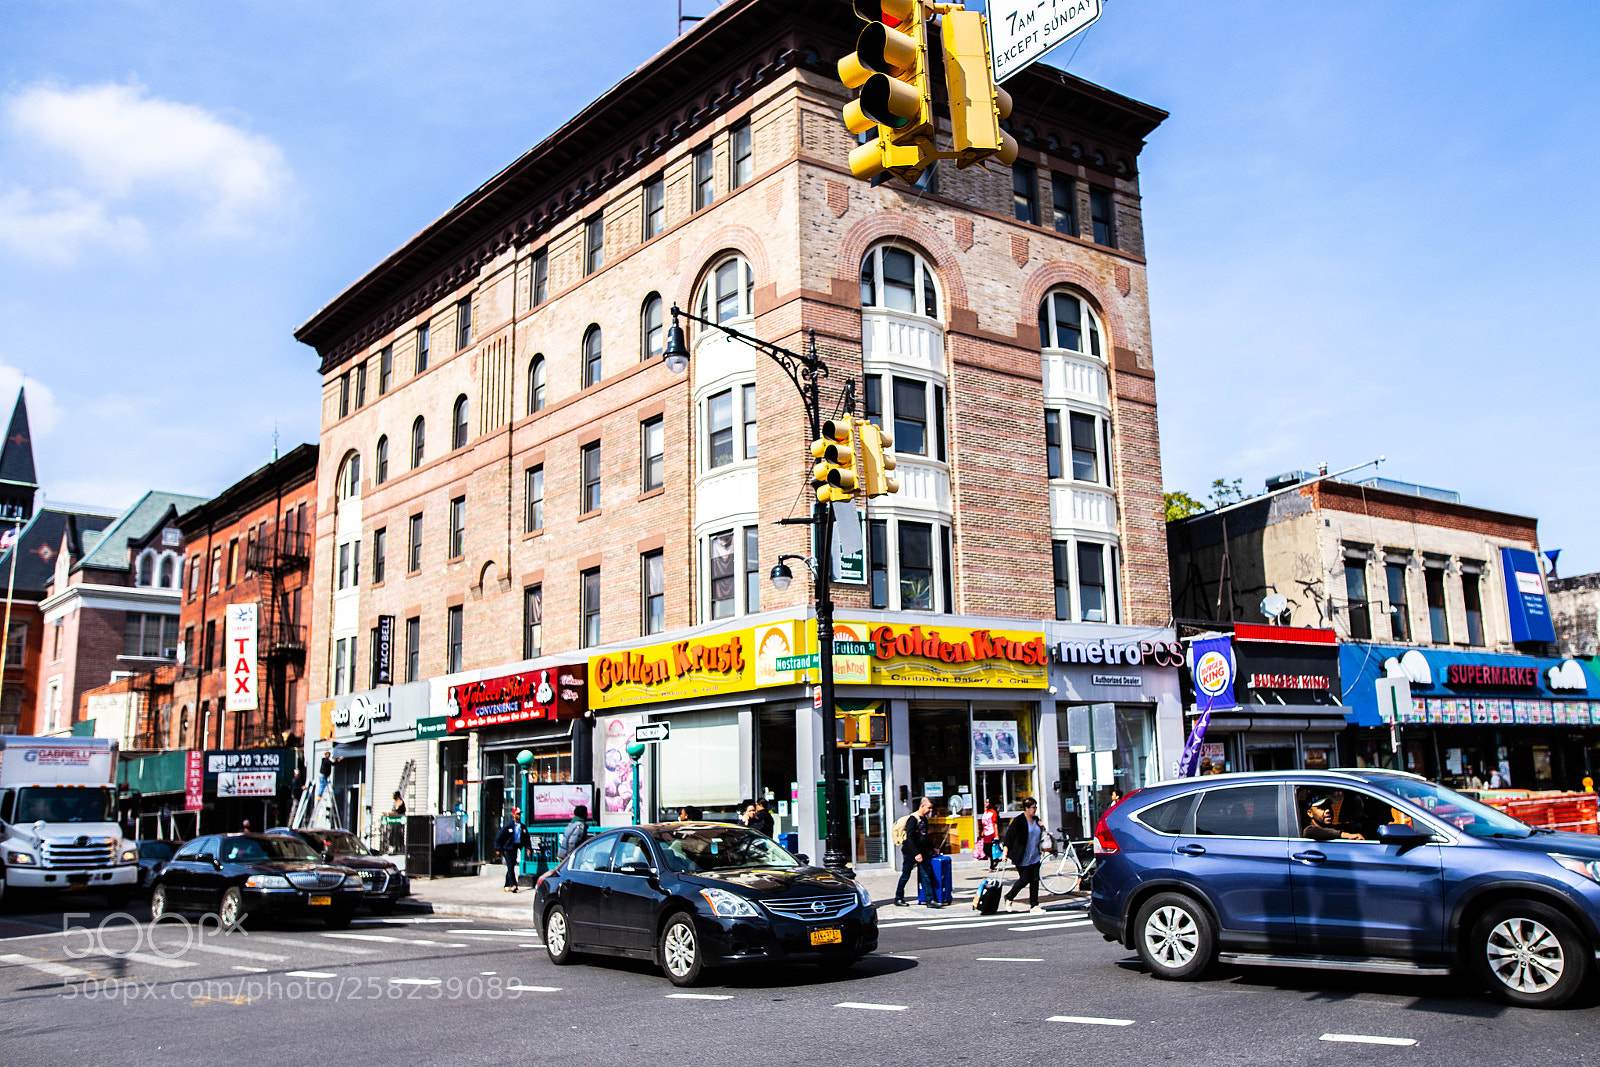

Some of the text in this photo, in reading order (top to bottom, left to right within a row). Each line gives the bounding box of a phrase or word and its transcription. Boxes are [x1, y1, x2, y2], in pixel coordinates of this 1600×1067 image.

[1005, 10, 1036, 36] 7AM
[996, 0, 1091, 68] EXCEPT SUNDAY
[380, 617, 390, 669] TACO BELL
[835, 643, 866, 654] Fulton
[871, 626, 1049, 666] Golden Krust
[1060, 638, 1185, 667] metroPCS
[234, 638, 250, 694] TAX
[594, 636, 746, 690] Golden Krust
[776, 656, 811, 671] Nostrand
[1201, 660, 1223, 676] BURGER
[891, 674, 949, 682] Caribbean
[954, 676, 991, 684] Bakery
[1123, 676, 1140, 685] Dealer
[1202, 667, 1225, 686] KING
[1253, 673, 1330, 689] BURGER KING
[1450, 664, 1540, 686] SUPERMARKET
[462, 676, 531, 706] Tobacco Shop
[330, 708, 349, 724] TACO
[475, 701, 519, 717] CONVENIENCE
[38, 749, 92, 758] GABRIELLI
[226, 754, 239, 767] UP
[240, 754, 251, 766] TO
